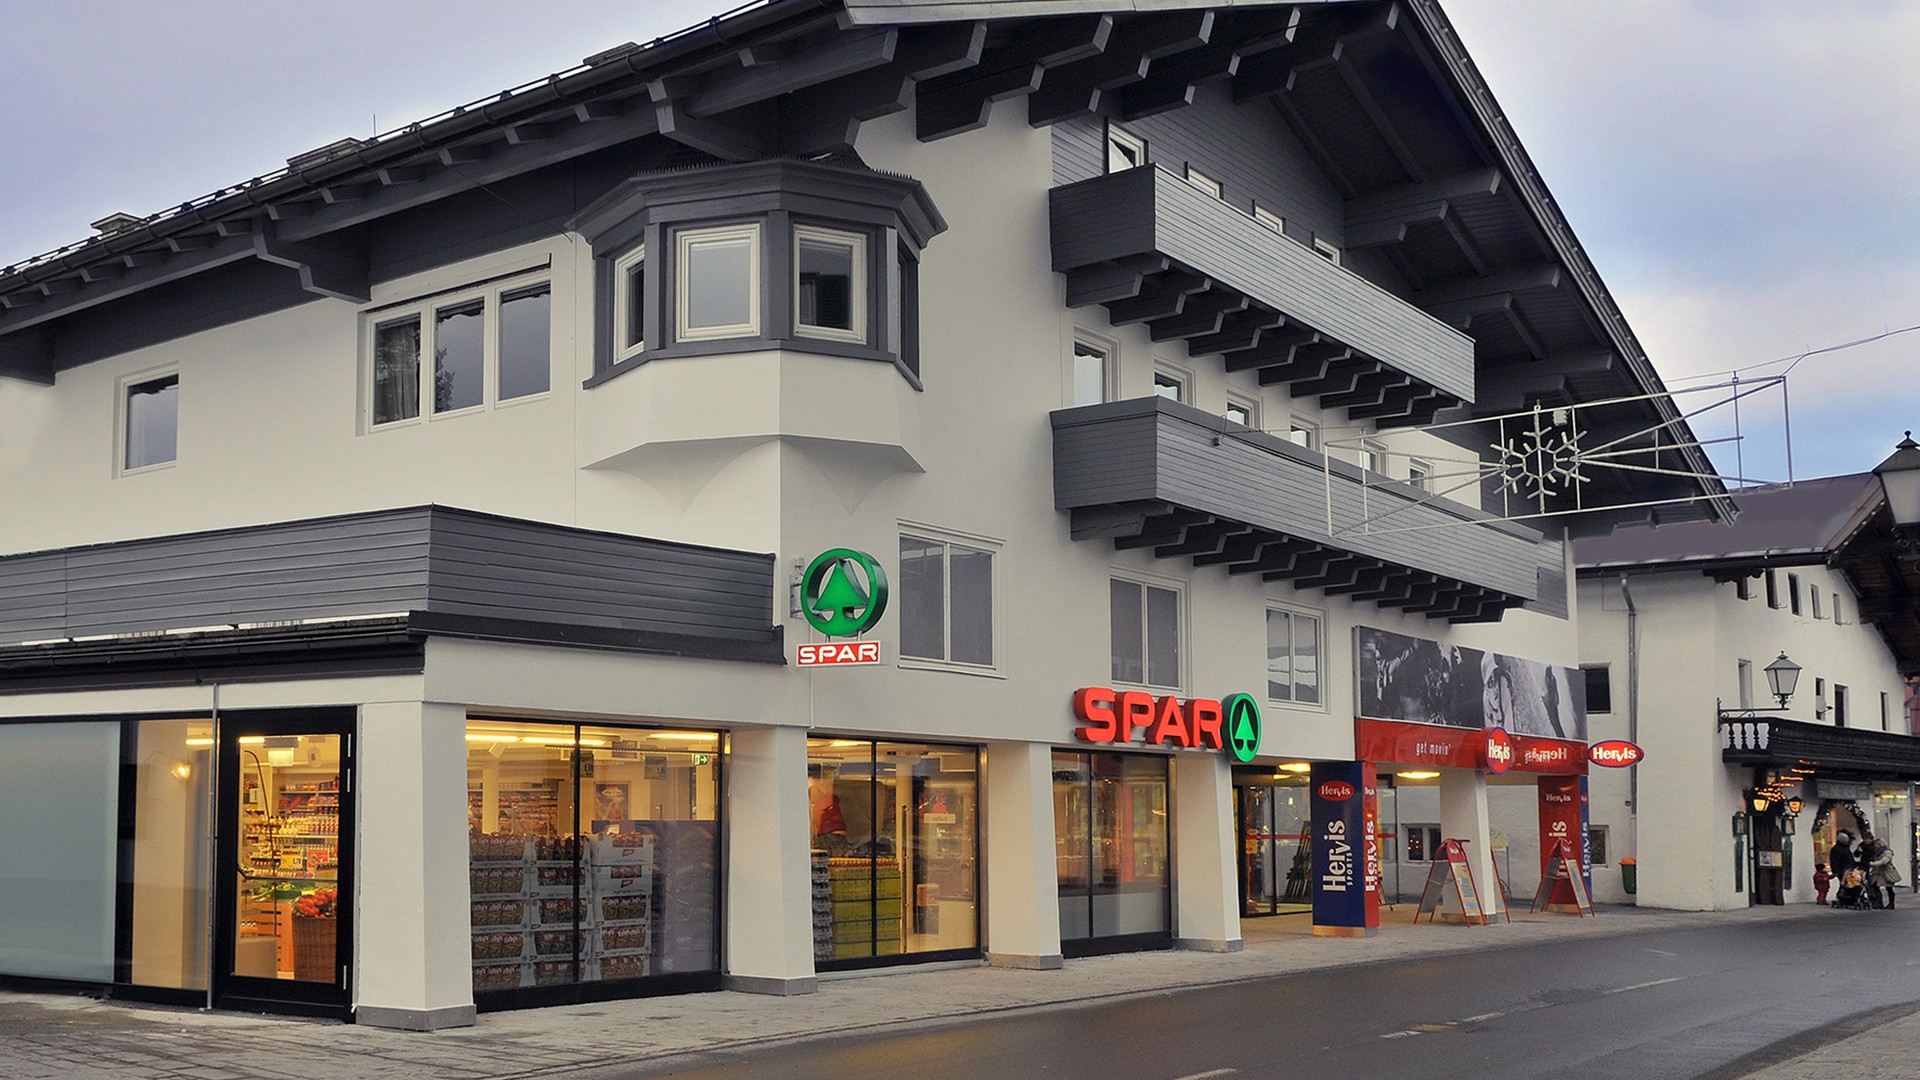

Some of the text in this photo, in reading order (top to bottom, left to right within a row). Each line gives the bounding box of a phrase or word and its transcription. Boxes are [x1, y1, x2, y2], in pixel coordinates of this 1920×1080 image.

[800, 644, 877, 663] SPAR
[1076, 687, 1223, 749] SPAR
[1416, 741, 1427, 756] get
[1488, 738, 1511, 763] Hervis
[1593, 747, 1637, 762] Hervis
[1321, 785, 1351, 797] Hervis
[1546, 793, 1571, 803] Hervis
[1322, 820, 1351, 892] Hervis
[1365, 820, 1377, 892] Hervis
[1346, 852, 1354, 886] SPORTS
